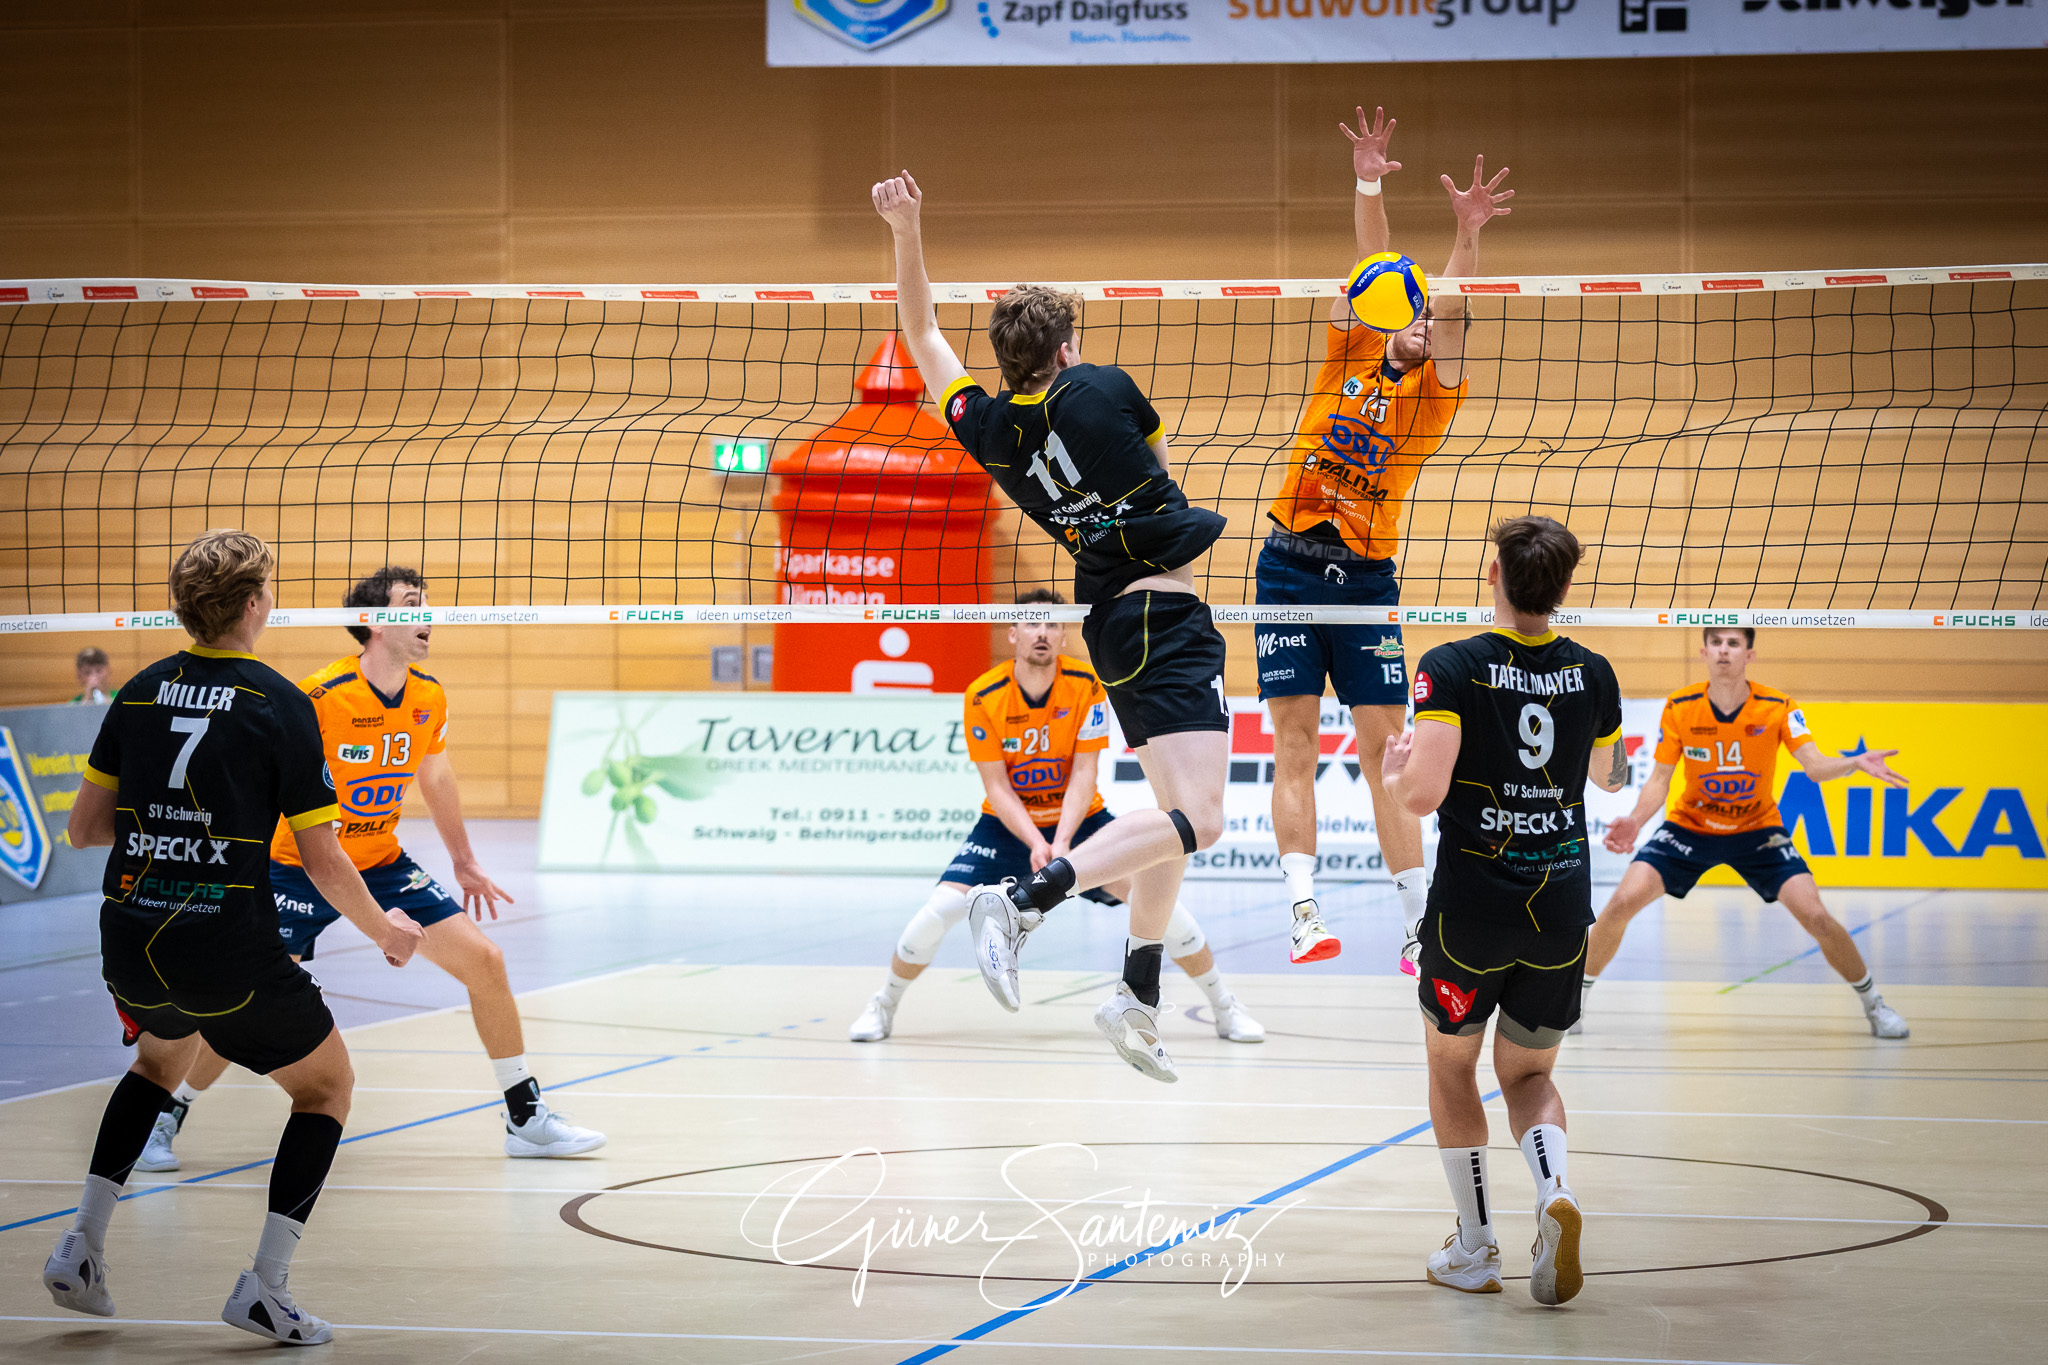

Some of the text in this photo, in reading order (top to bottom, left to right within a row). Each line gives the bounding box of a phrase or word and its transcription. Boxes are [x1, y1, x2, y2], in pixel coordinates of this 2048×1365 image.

[1004, 0, 1189, 27] Zapf Daigfuss
[1025, 430, 1082, 501] 11
[1062, 491, 1102, 515] Schwaig
[376, 612, 432, 622] FUCHS
[445, 610, 539, 622] Ideen umsetzen
[626, 610, 684, 620] FUCHS
[696, 610, 792, 621] Ideen umsetzen
[882, 610, 940, 620] FUCHS
[953, 609, 1050, 621] Ideen umsetzen
[1214, 609, 1313, 622] Ideen umsetzen
[1406, 612, 1467, 622] FUCHS
[1480, 611, 1582, 624] Ide etzen
[1676, 614, 1738, 624] FUCHS
[1752, 614, 1855, 626] Ideen umsetzen
[1952, 616, 2016, 626] FUCHS
[2030, 615, 2048, 627] Ide
[0, 619, 48, 631] msetzen
[1380, 663, 1403, 685] 15
[1488, 663, 1585, 696] TAFELMAYER
[156, 681, 236, 712] MILLER
[1210, 674, 1230, 717] 1
[352, 714, 384, 726] panzeri
[697, 715, 936, 755] Taverna
[1024, 724, 1050, 756] 28
[1518, 702, 1555, 770] 9
[168, 715, 211, 790] 7
[380, 732, 412, 767] 13
[1715, 740, 1743, 767] 14
[706, 758, 772, 775] GREEK
[1012, 763, 1062, 786] ODU
[351, 780, 410, 807] ODU
[1503, 783, 1564, 800] SV Schwaig
[1704, 779, 1756, 795] ODU
[148, 804, 212, 826] SV Schwaig
[770, 808, 812, 823] Tel.:
[820, 808, 869, 823] 0911
[893, 808, 931, 823] 500
[939, 809, 976, 823] 200
[1480, 807, 1559, 835] SPECK
[693, 826, 777, 843] Schwaig
[799, 826, 969, 844] Behringersdorfe
[126, 833, 203, 864] SPECK
[142, 877, 226, 900] FUCHS
[170, 900, 221, 914] umsetzen
